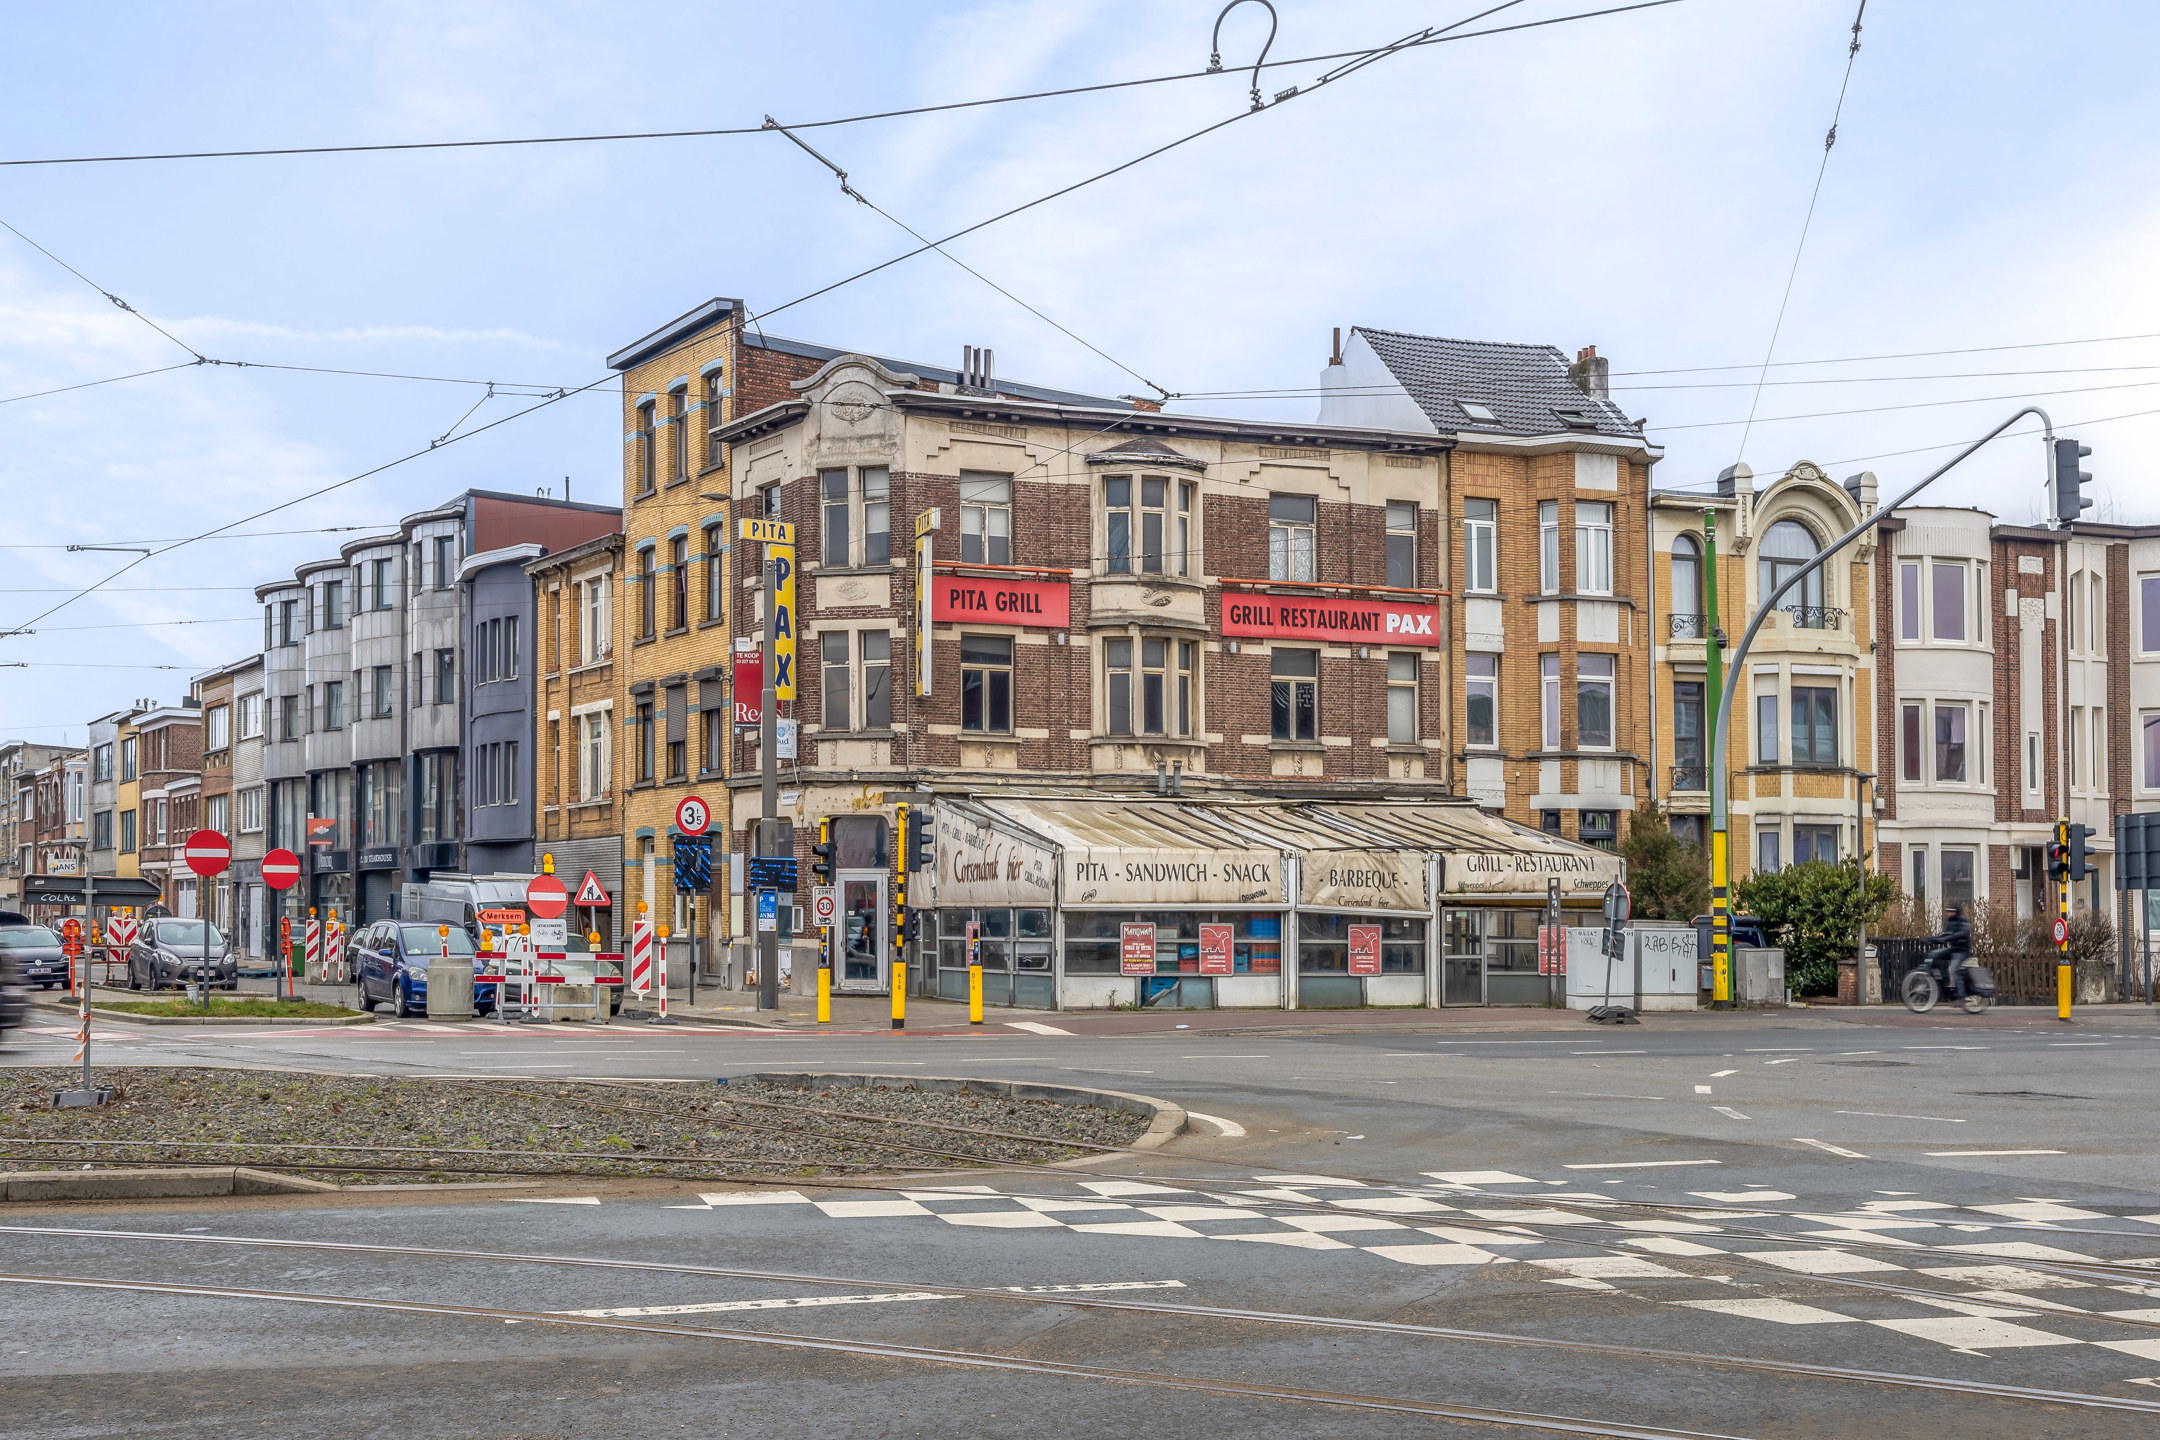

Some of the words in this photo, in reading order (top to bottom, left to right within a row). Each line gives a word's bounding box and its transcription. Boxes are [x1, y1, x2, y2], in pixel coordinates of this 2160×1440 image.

[751, 521, 787, 540] PITA
[918, 512, 930, 533] PITA
[950, 588, 988, 611] PITA
[995, 591, 1043, 614] GRILL
[774, 556, 792, 688] PAX
[1230, 604, 1274, 626] GRILL
[1280, 607, 1381, 632] RESTAURANT
[1386, 613, 1433, 635] PAX
[942, 821, 950, 836] PITA
[952, 826, 962, 842] GRILL
[954, 843, 1002, 884] Corsendonk
[1006, 846, 1023, 882] bier
[1076, 863, 1109, 882] PITA
[1125, 863, 1207, 882] SANDWICH
[1223, 863, 1271, 883] SNACK
[1467, 855, 1504, 873] GRILL
[1515, 856, 1595, 873] RESTAURANT
[1330, 869, 1398, 892] BARBEQUE
[1573, 878, 1609, 891] Schweppes
[820, 902, 831, 911] 30
[1338, 894, 1373, 907] Corsendonk
[1378, 896, 1390, 907] bier
[486, 912, 522, 920] Merksem
[1123, 926, 1153, 940] MANOWAR
